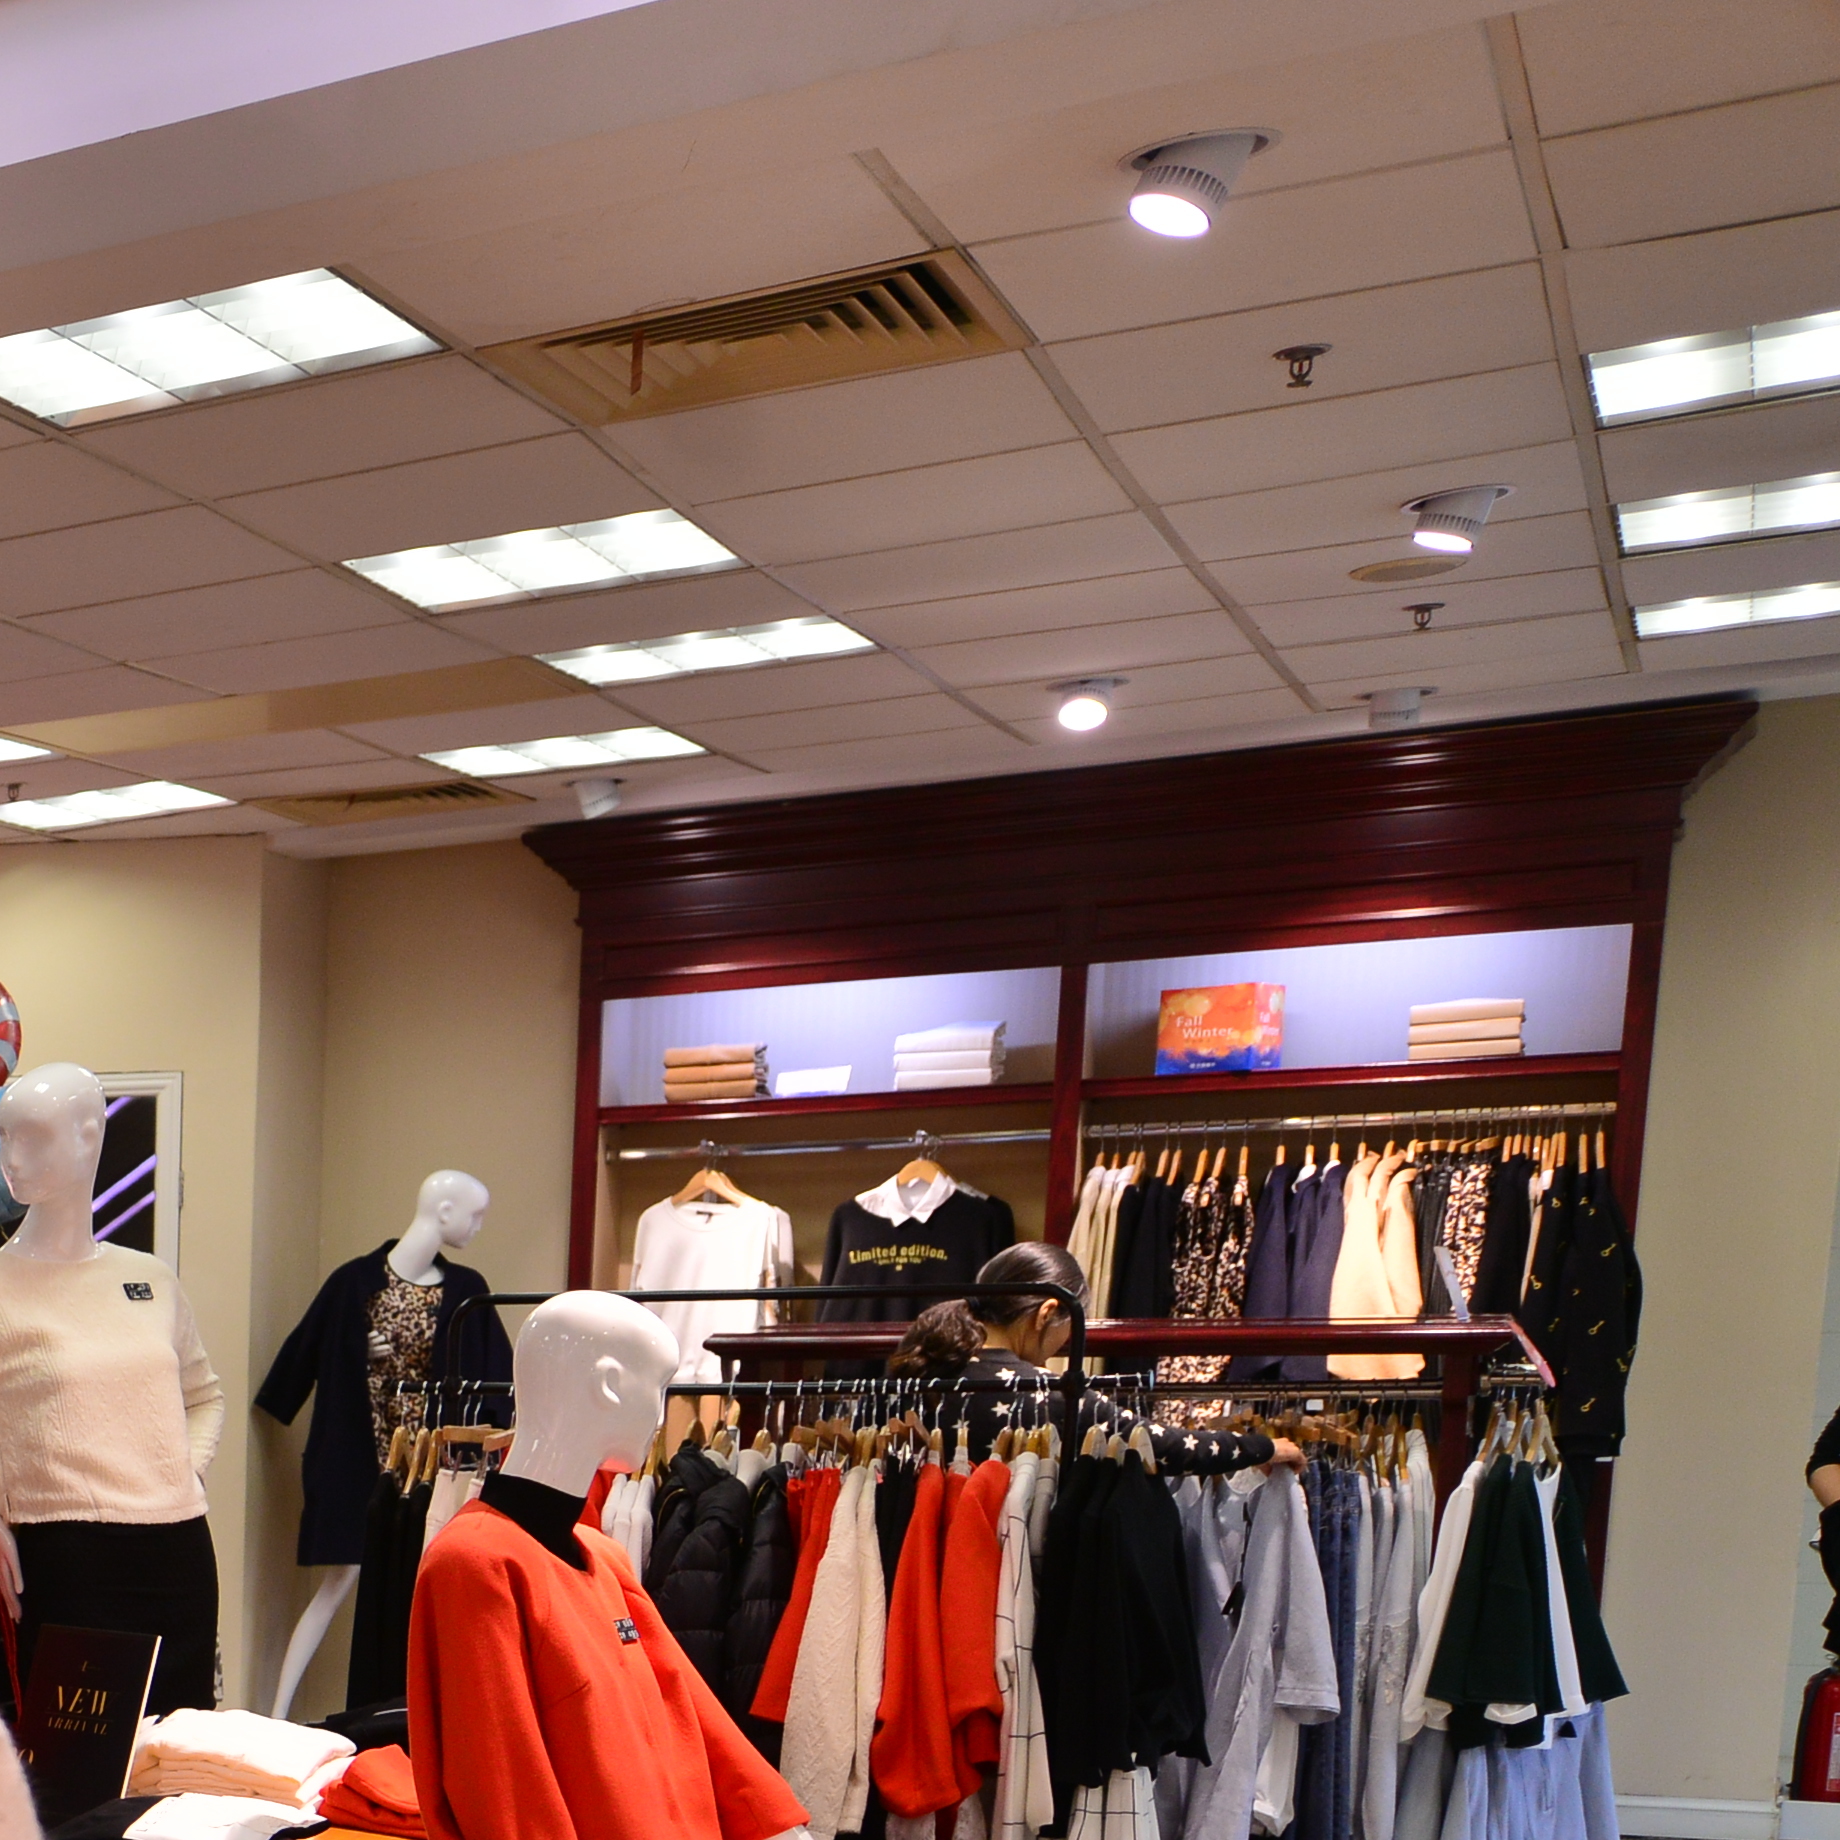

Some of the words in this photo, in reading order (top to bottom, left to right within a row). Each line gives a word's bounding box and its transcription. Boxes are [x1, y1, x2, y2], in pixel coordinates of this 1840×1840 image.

[1176, 1016, 1202, 1028] Fall
[1183, 1028, 1233, 1038] Winter
[849, 1244, 897, 1265] Limited
[51, 1685, 116, 1716] NEW
[46, 1717, 110, 1735] ARRIVAL
